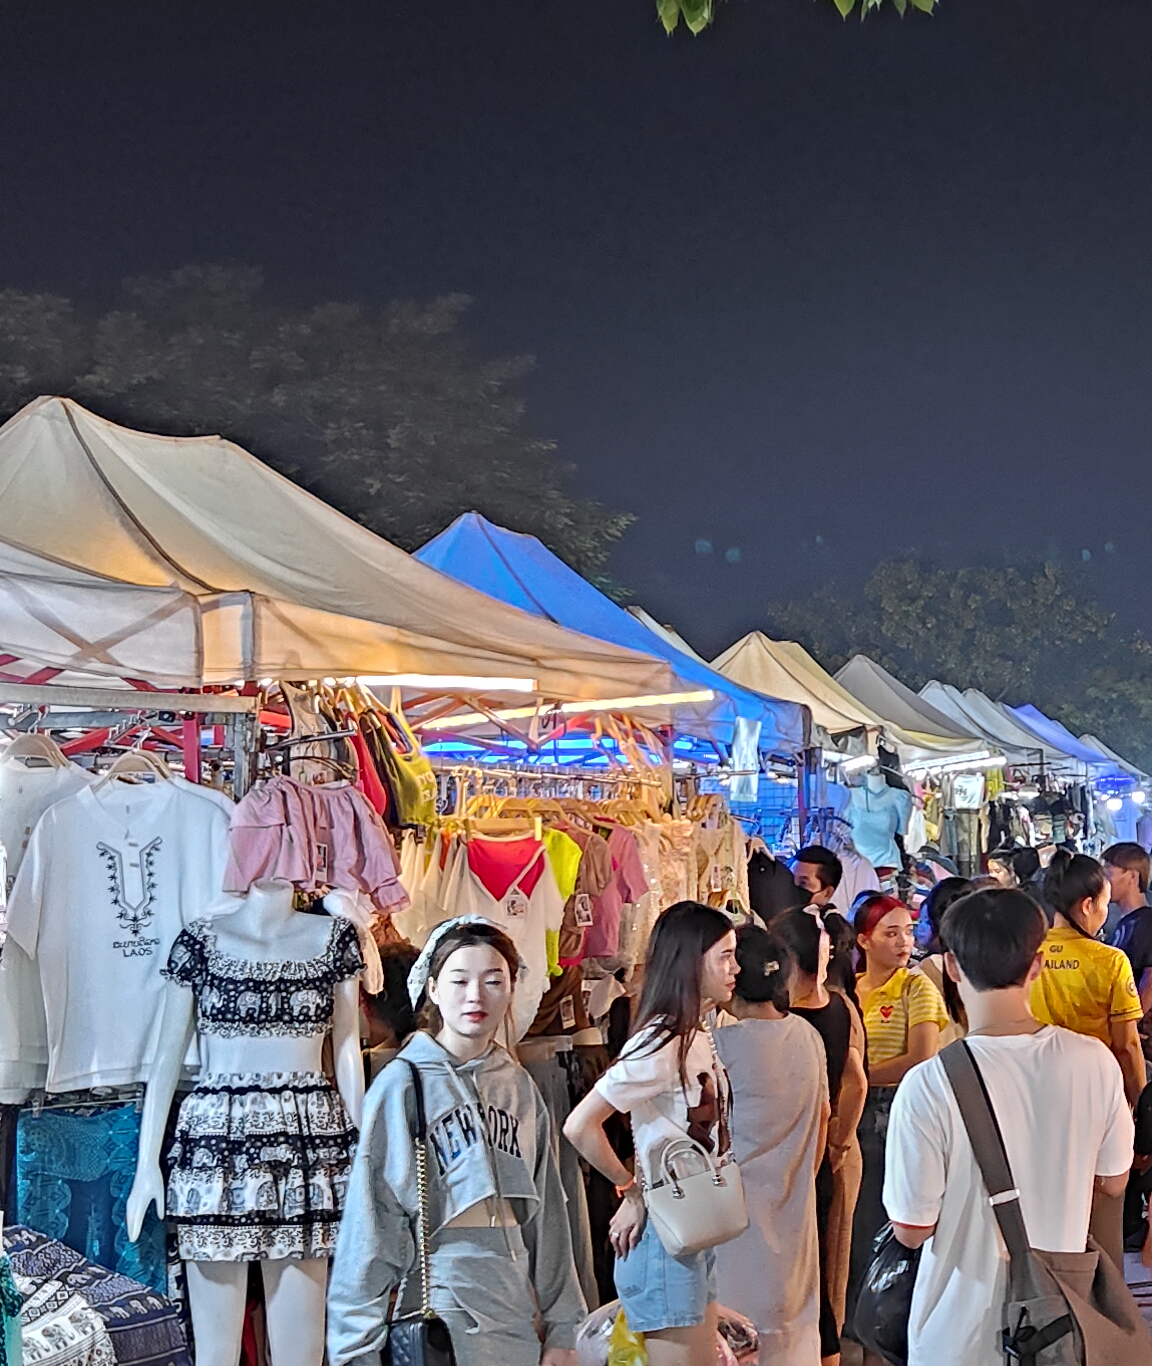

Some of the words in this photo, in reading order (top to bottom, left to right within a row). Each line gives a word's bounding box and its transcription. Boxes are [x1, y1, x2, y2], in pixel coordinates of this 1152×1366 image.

[123, 947, 153, 958] LAOS
[1044, 959, 1080, 970] AILAND
[429, 1103, 478, 1177] NEW
